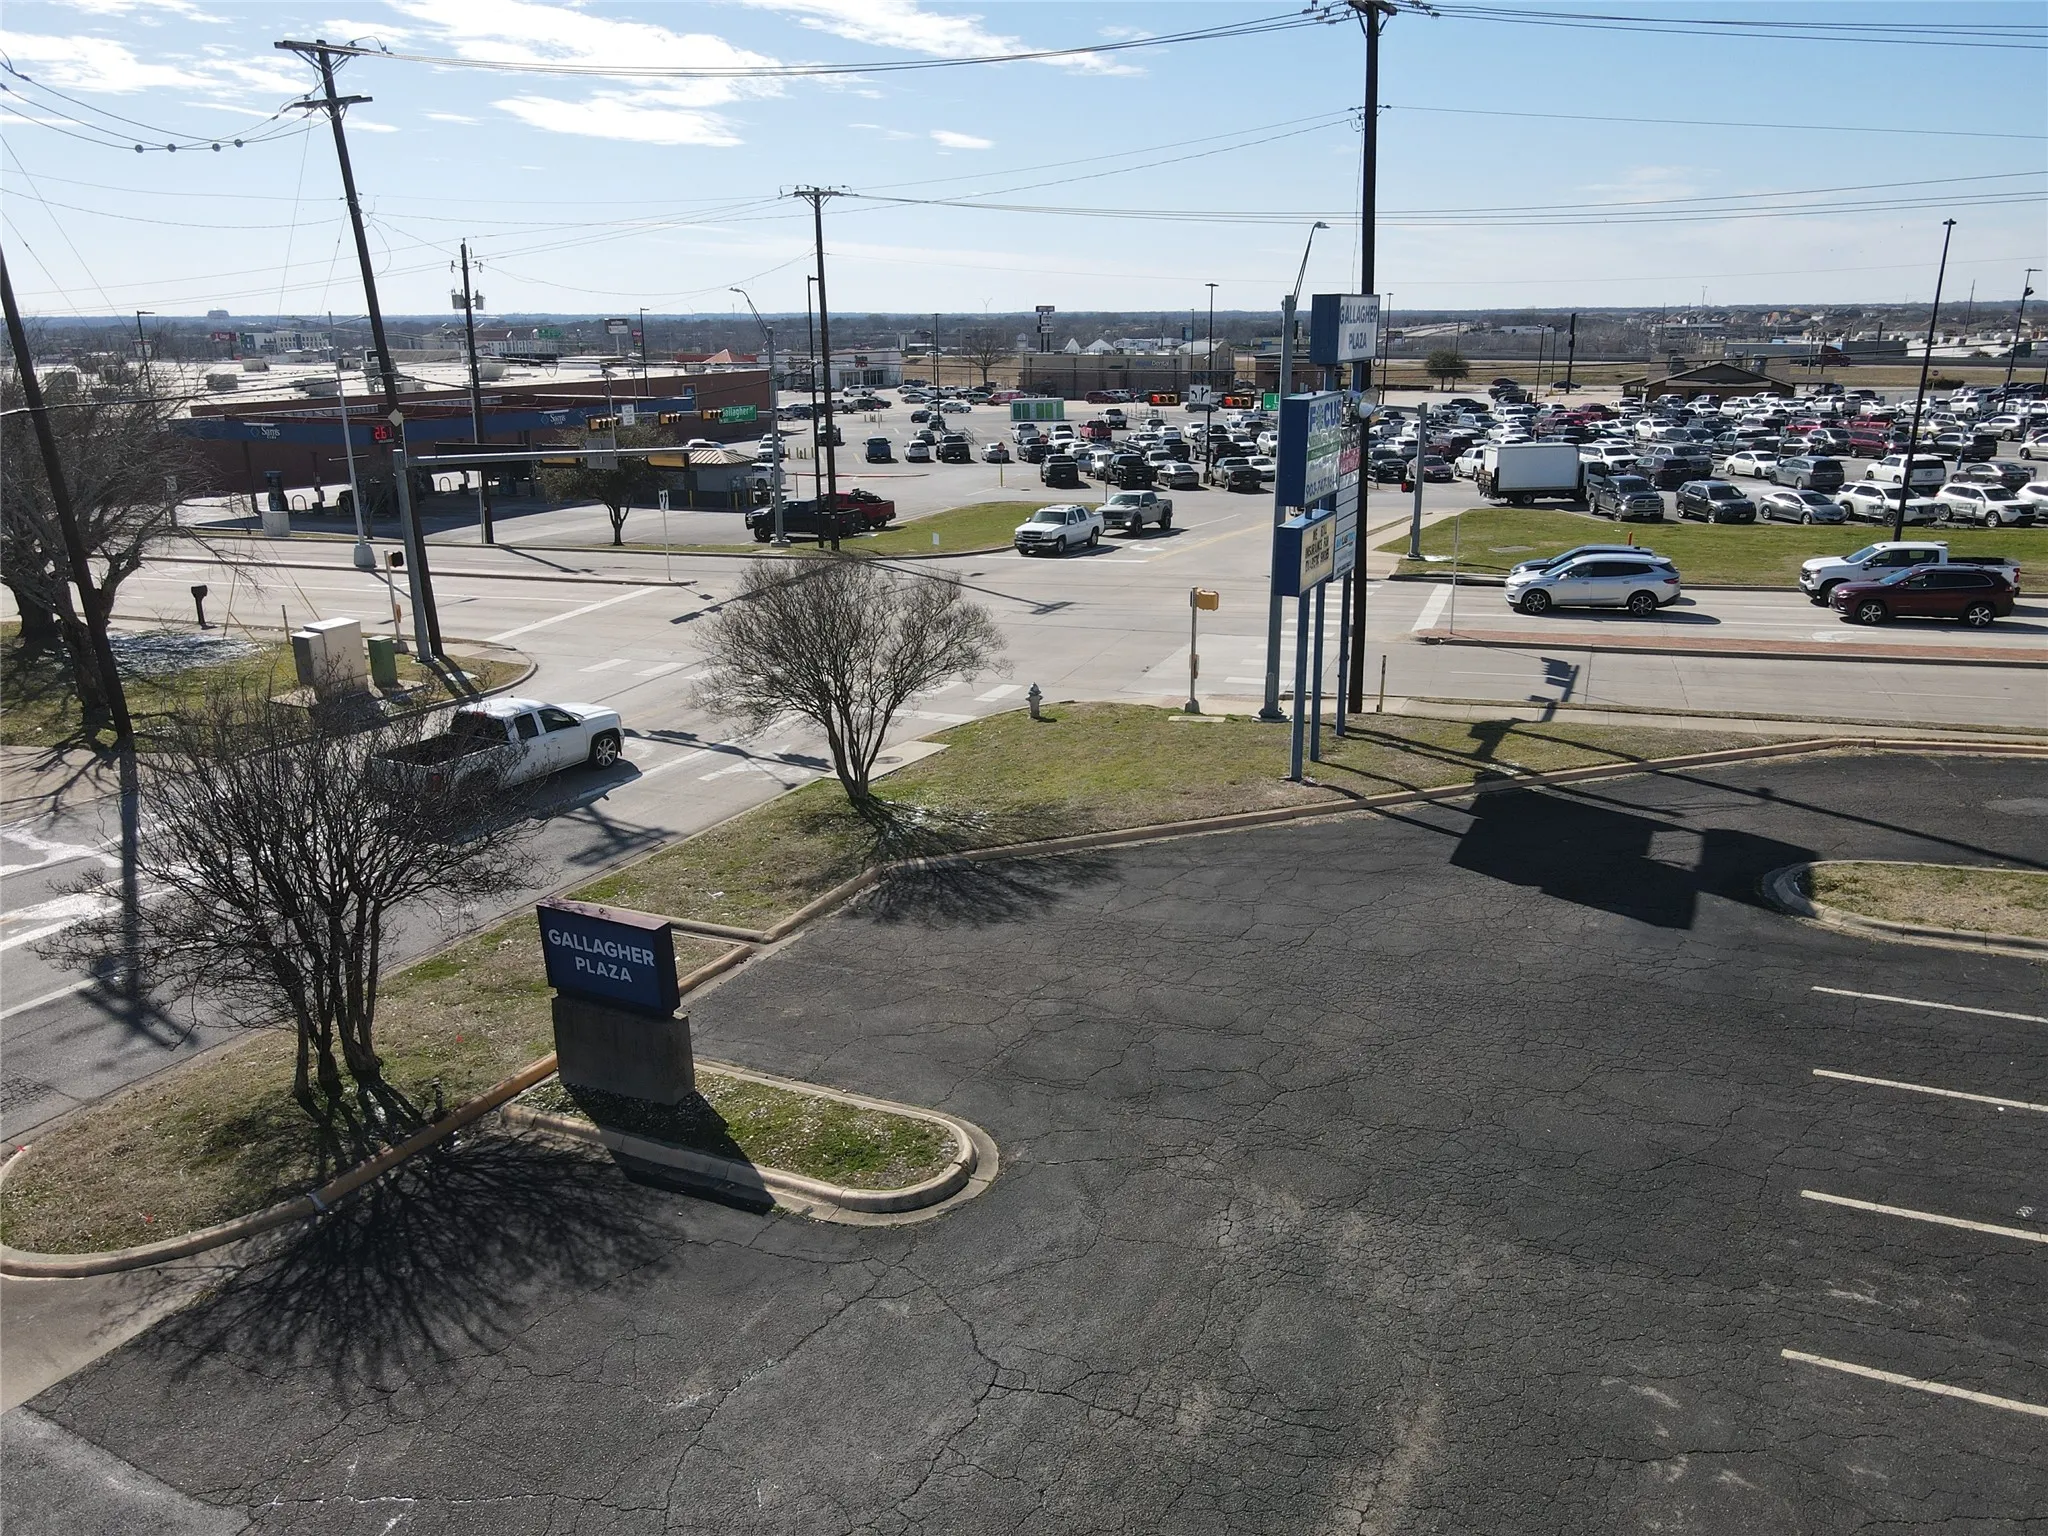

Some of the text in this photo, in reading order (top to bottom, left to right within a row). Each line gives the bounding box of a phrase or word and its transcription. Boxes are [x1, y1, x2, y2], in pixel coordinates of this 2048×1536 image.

[1340, 305, 1377, 324] GALLAGHER
[1349, 332, 1367, 349] PLAZA
[721, 407, 749, 419] allagher
[548, 929, 655, 967] GALLAGHER
[575, 956, 633, 983] PLAZA
